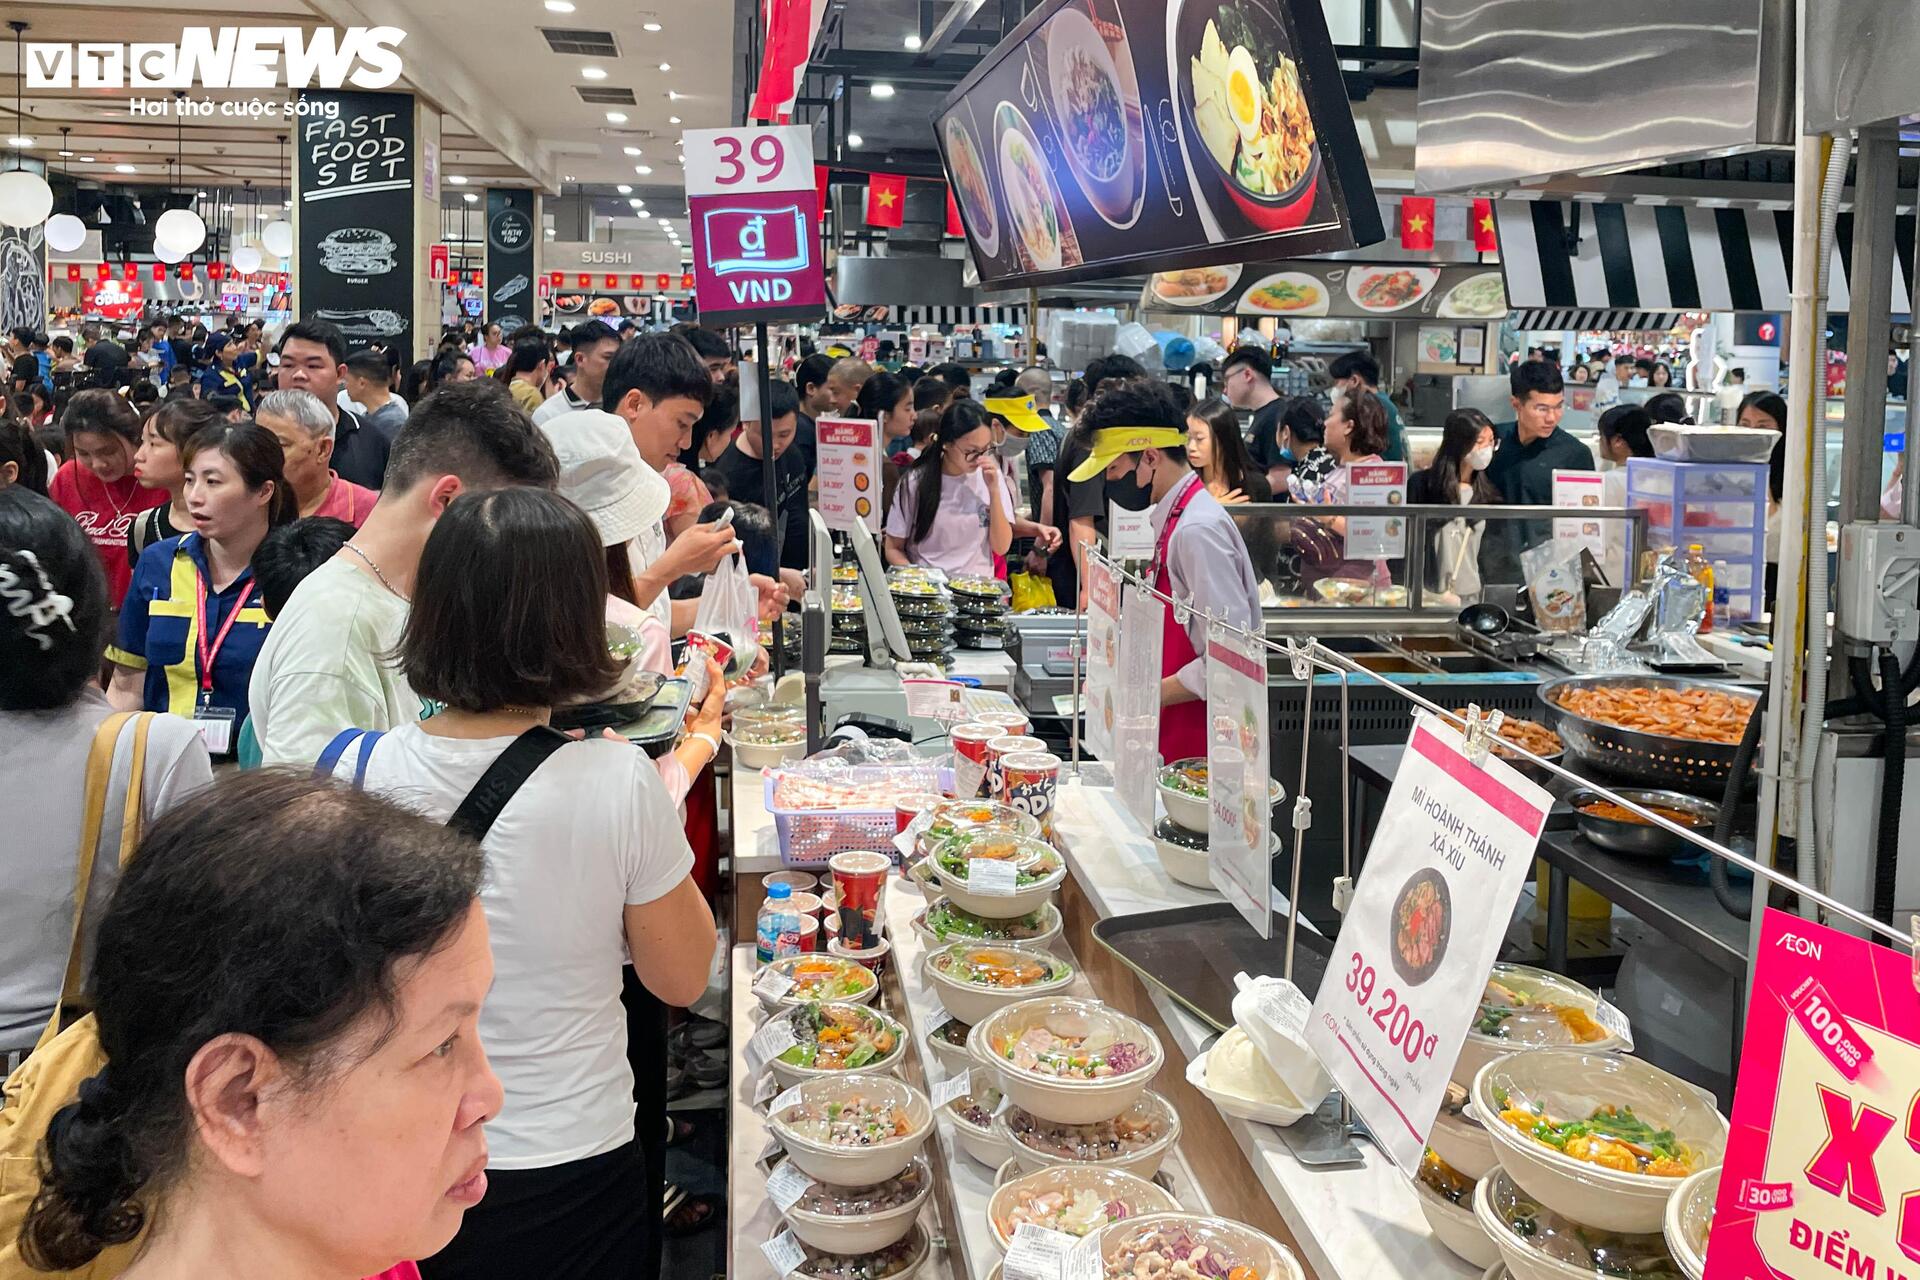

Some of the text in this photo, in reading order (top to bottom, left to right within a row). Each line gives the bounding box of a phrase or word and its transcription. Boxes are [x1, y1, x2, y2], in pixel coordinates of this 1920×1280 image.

[305, 114, 396, 142] FAST
[311, 138, 405, 164] FOOD
[713, 134, 785, 185] 39
[317, 157, 405, 186] SET
[581, 251, 632, 264] SUSHI
[728, 278, 792, 304] VND
[1411, 786, 1506, 871] MÌ HOÀNH THÁNH
[1430, 831, 1466, 871] XÁ XÍU
[1835, 1045, 1857, 1067] VND
